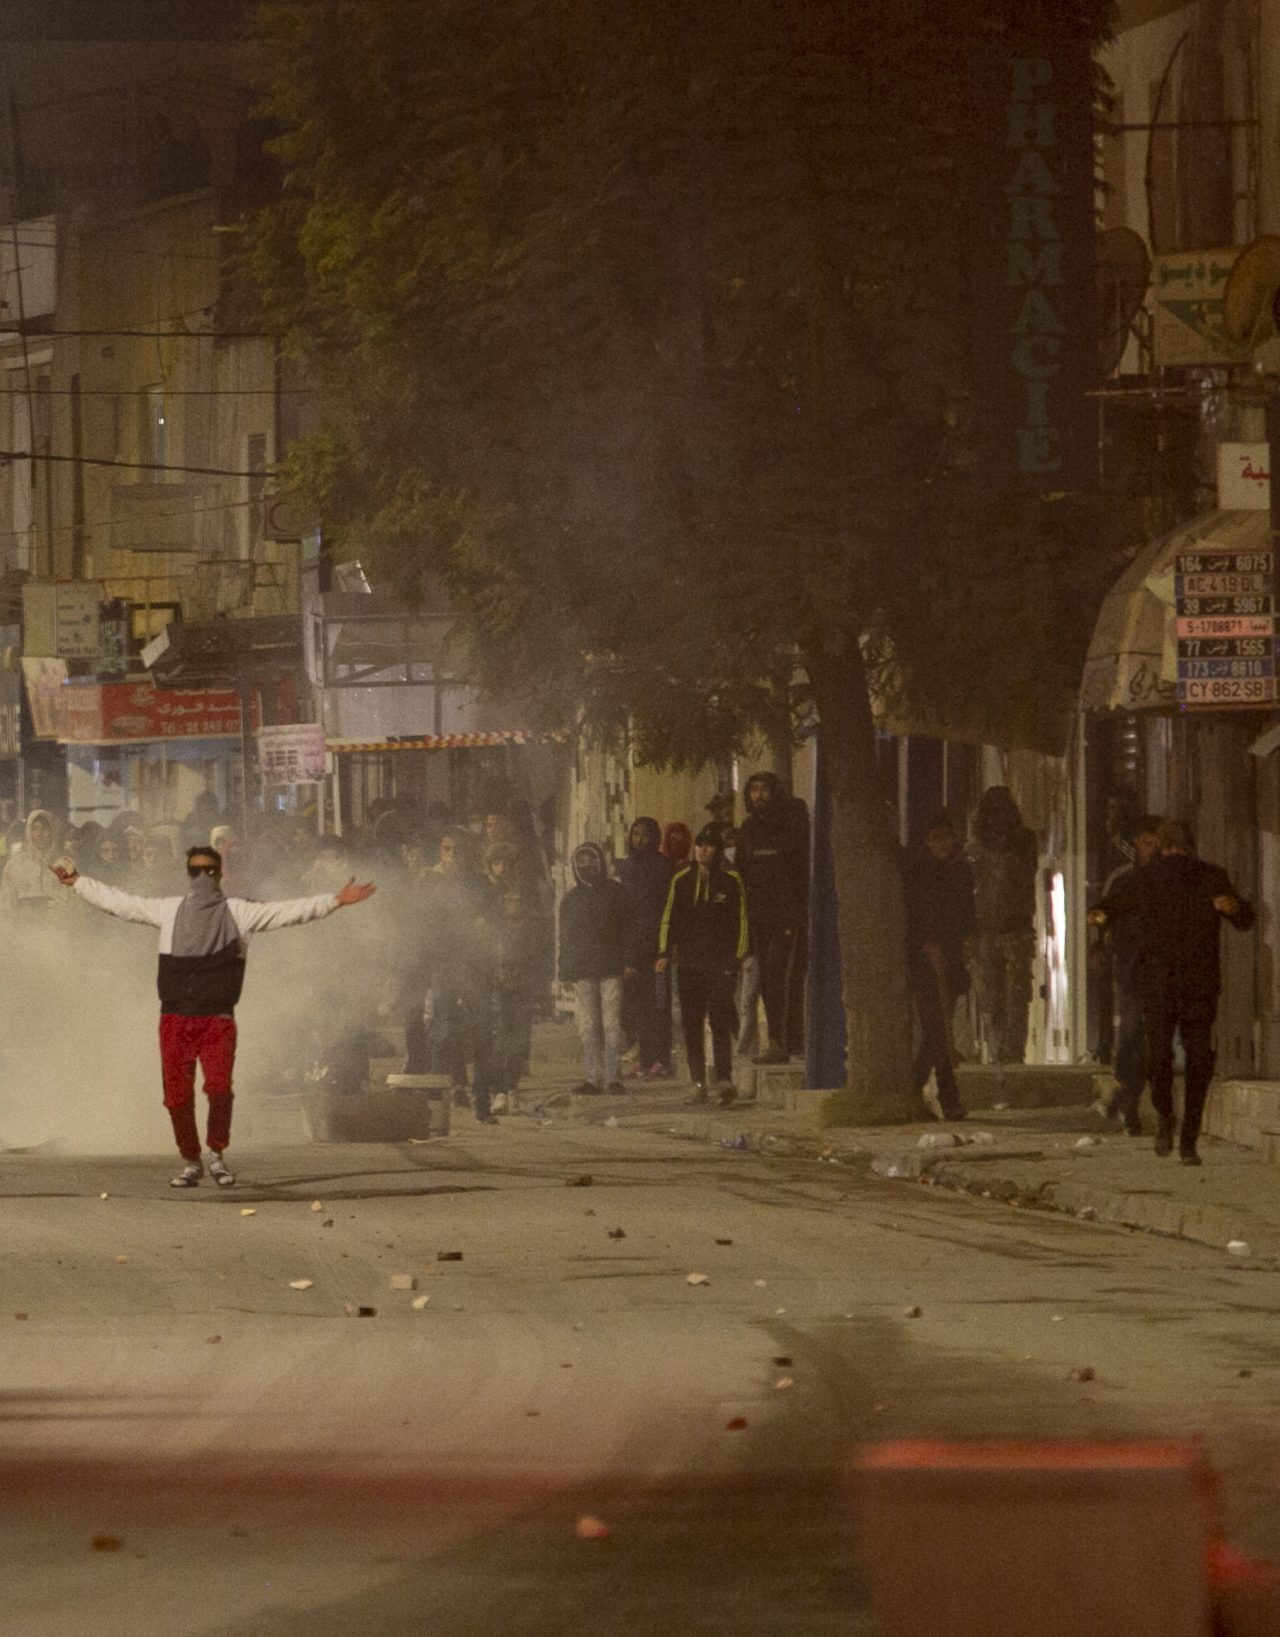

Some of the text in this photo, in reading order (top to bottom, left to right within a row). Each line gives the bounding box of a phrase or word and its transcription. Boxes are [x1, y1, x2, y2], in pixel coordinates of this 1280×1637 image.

[1006, 57, 1065, 472] PHARMACIE
[1180, 556, 1202, 572] 164
[1236, 555, 1267, 572] 6075
[1183, 598, 1200, 614] 39
[1186, 640, 1201, 656] 77
[1235, 639, 1266, 655] 1565
[1187, 661, 1209, 677] 173
